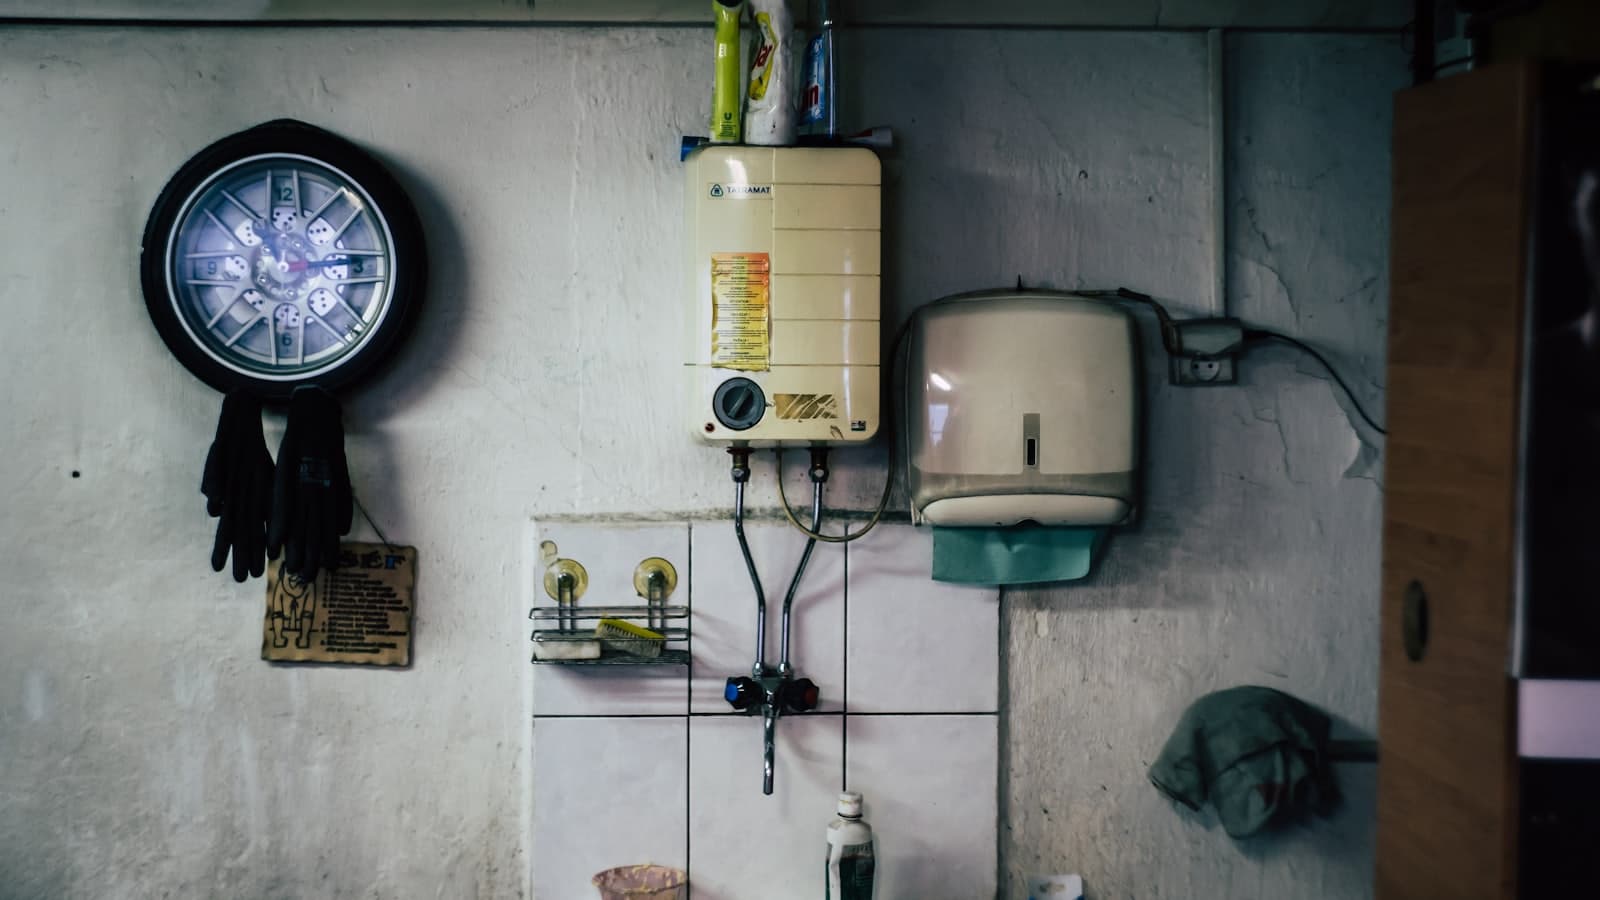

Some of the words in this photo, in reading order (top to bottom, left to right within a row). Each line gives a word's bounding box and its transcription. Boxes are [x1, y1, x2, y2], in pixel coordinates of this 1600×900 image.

[279, 187, 294, 201] 12
[726, 185, 771, 194] TATRAMAT
[207, 260, 217, 275] 9
[353, 258, 364, 274] 3
[281, 333, 292, 347] 6
